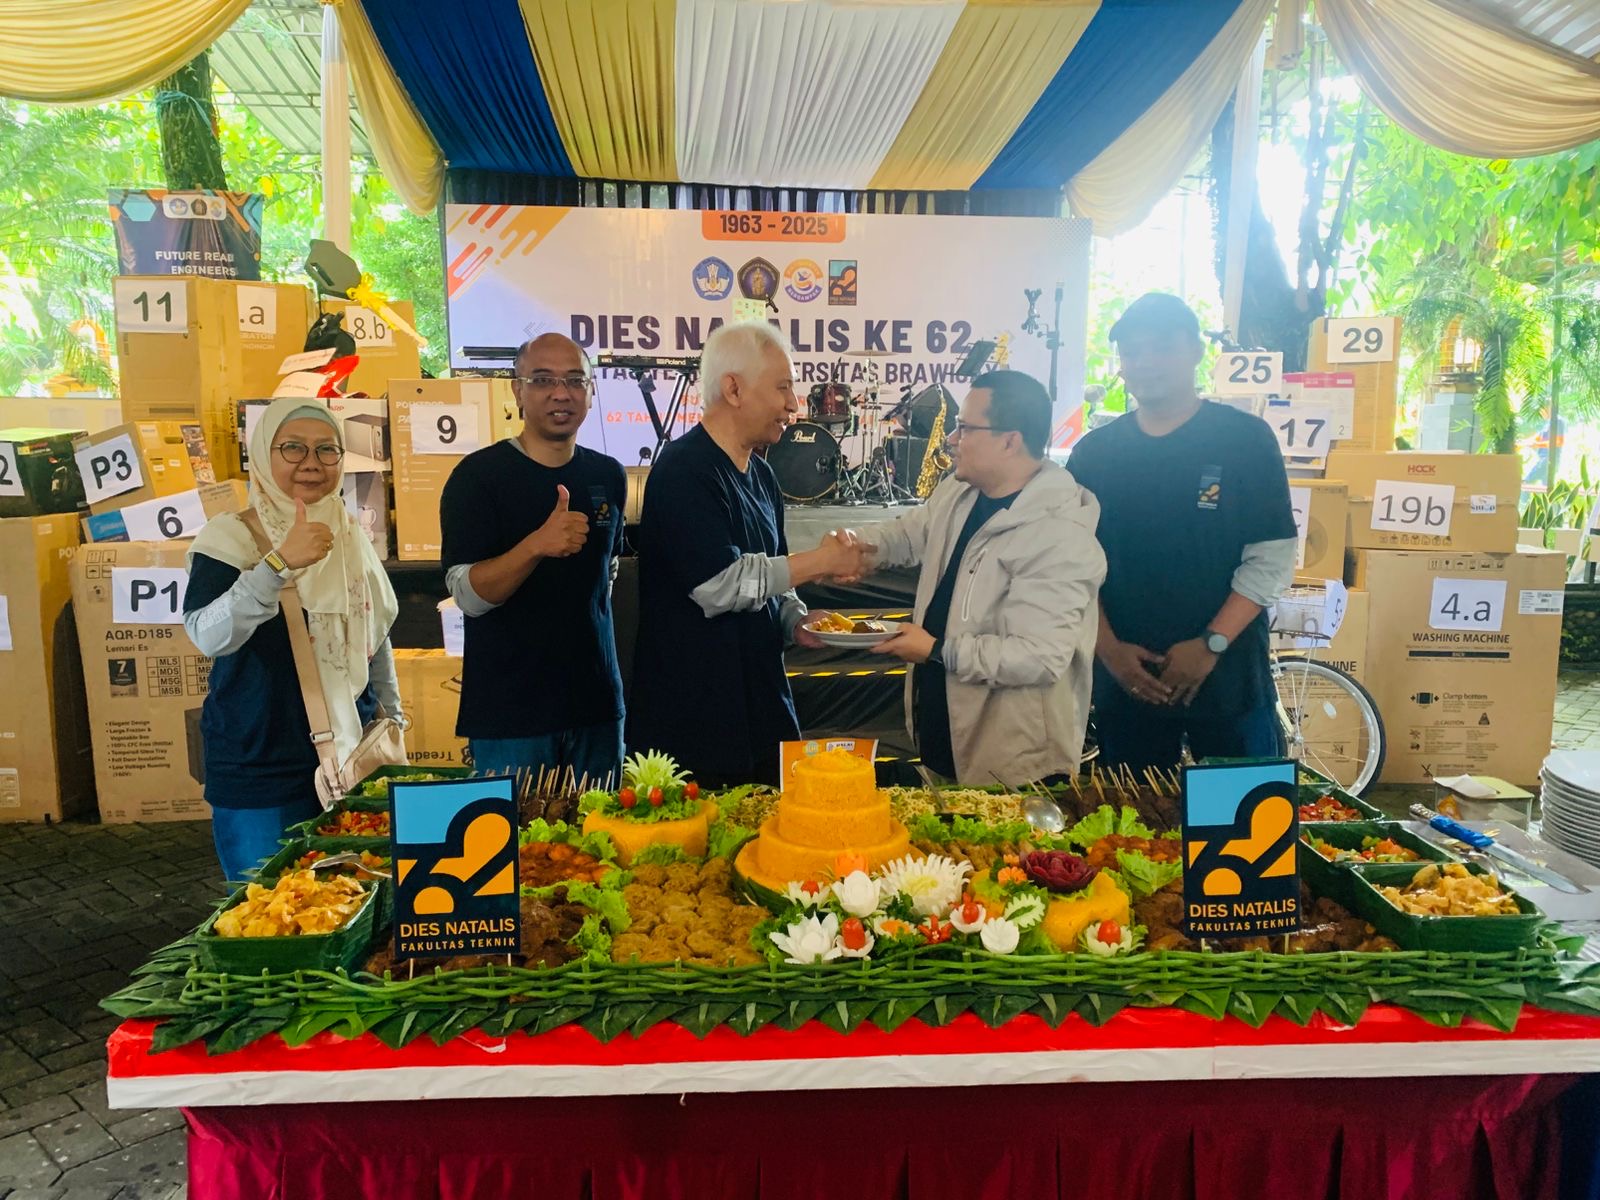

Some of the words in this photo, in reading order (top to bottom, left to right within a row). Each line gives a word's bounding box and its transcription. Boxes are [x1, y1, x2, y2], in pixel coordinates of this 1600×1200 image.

[720, 214, 762, 234] 1963
[781, 215, 828, 235] 2025
[155, 251, 201, 261] FUTURE
[171, 265, 236, 277] ENGINEERS
[133, 291, 172, 322] 11
[354, 317, 386, 340] 8.b
[570, 314, 661, 351] DIES
[864, 319, 913, 353] KE
[925, 320, 973, 354] 62
[1342, 327, 1383, 354] 29
[1228, 355, 1273, 385] 25
[606, 411, 622, 423] 62
[437, 414, 457, 444] 9
[793, 429, 816, 444] Pearl
[1280, 417, 1326, 448] 17
[90, 449, 133, 490] P3
[1407, 464, 1436, 473] HOCK
[1378, 494, 1446, 527] 19b
[157, 506, 183, 539] 6
[130, 579, 178, 614] P1
[1440, 592, 1491, 622] 4.a
[105, 628, 173, 641] AQR-D185
[1412, 632, 1460, 643] WASHING
[1462, 633, 1510, 644] MACHINE
[106, 644, 135, 653] Lemari
[138, 643, 148, 652] Es
[117, 661, 127, 673] 7
[159, 657, 178, 666] MLS
[159, 666, 179, 675] MDS
[160, 676, 180, 685] MSG
[161, 686, 181, 695] MSB
[1189, 903, 1229, 918] DIES
[1233, 898, 1297, 917] NATALIS
[400, 921, 440, 938] DIES
[445, 917, 516, 936] NATALIS
[1190, 921, 1251, 932] FAKULTAS
[1256, 916, 1297, 930] TEKNIK
[401, 938, 465, 952] FAKULTAS
[470, 936, 516, 949] TEKNIK
